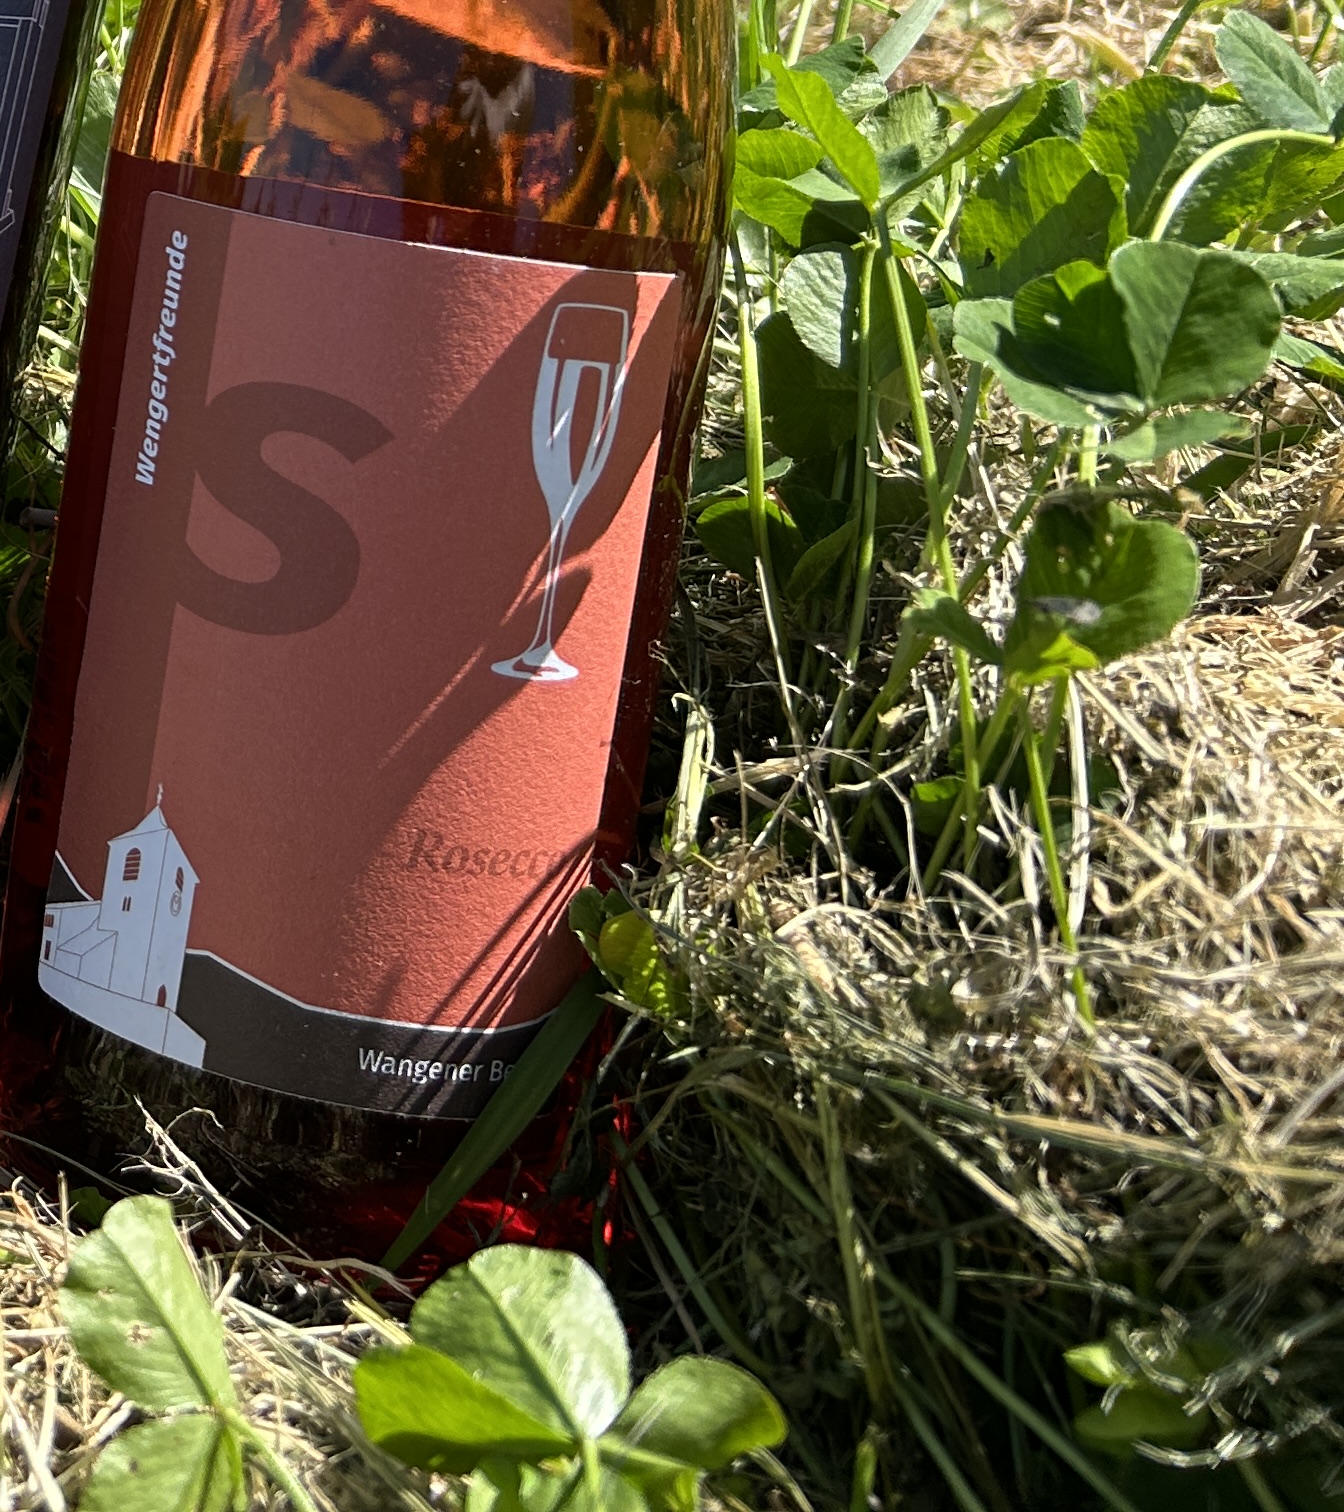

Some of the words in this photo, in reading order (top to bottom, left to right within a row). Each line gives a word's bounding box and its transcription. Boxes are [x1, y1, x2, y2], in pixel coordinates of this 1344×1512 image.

[135, 229, 189, 486] Wengertfreunde
[172, 380, 394, 636] S
[357, 1047, 485, 1086] Wangener
[488, 1059, 518, 1083] Be
